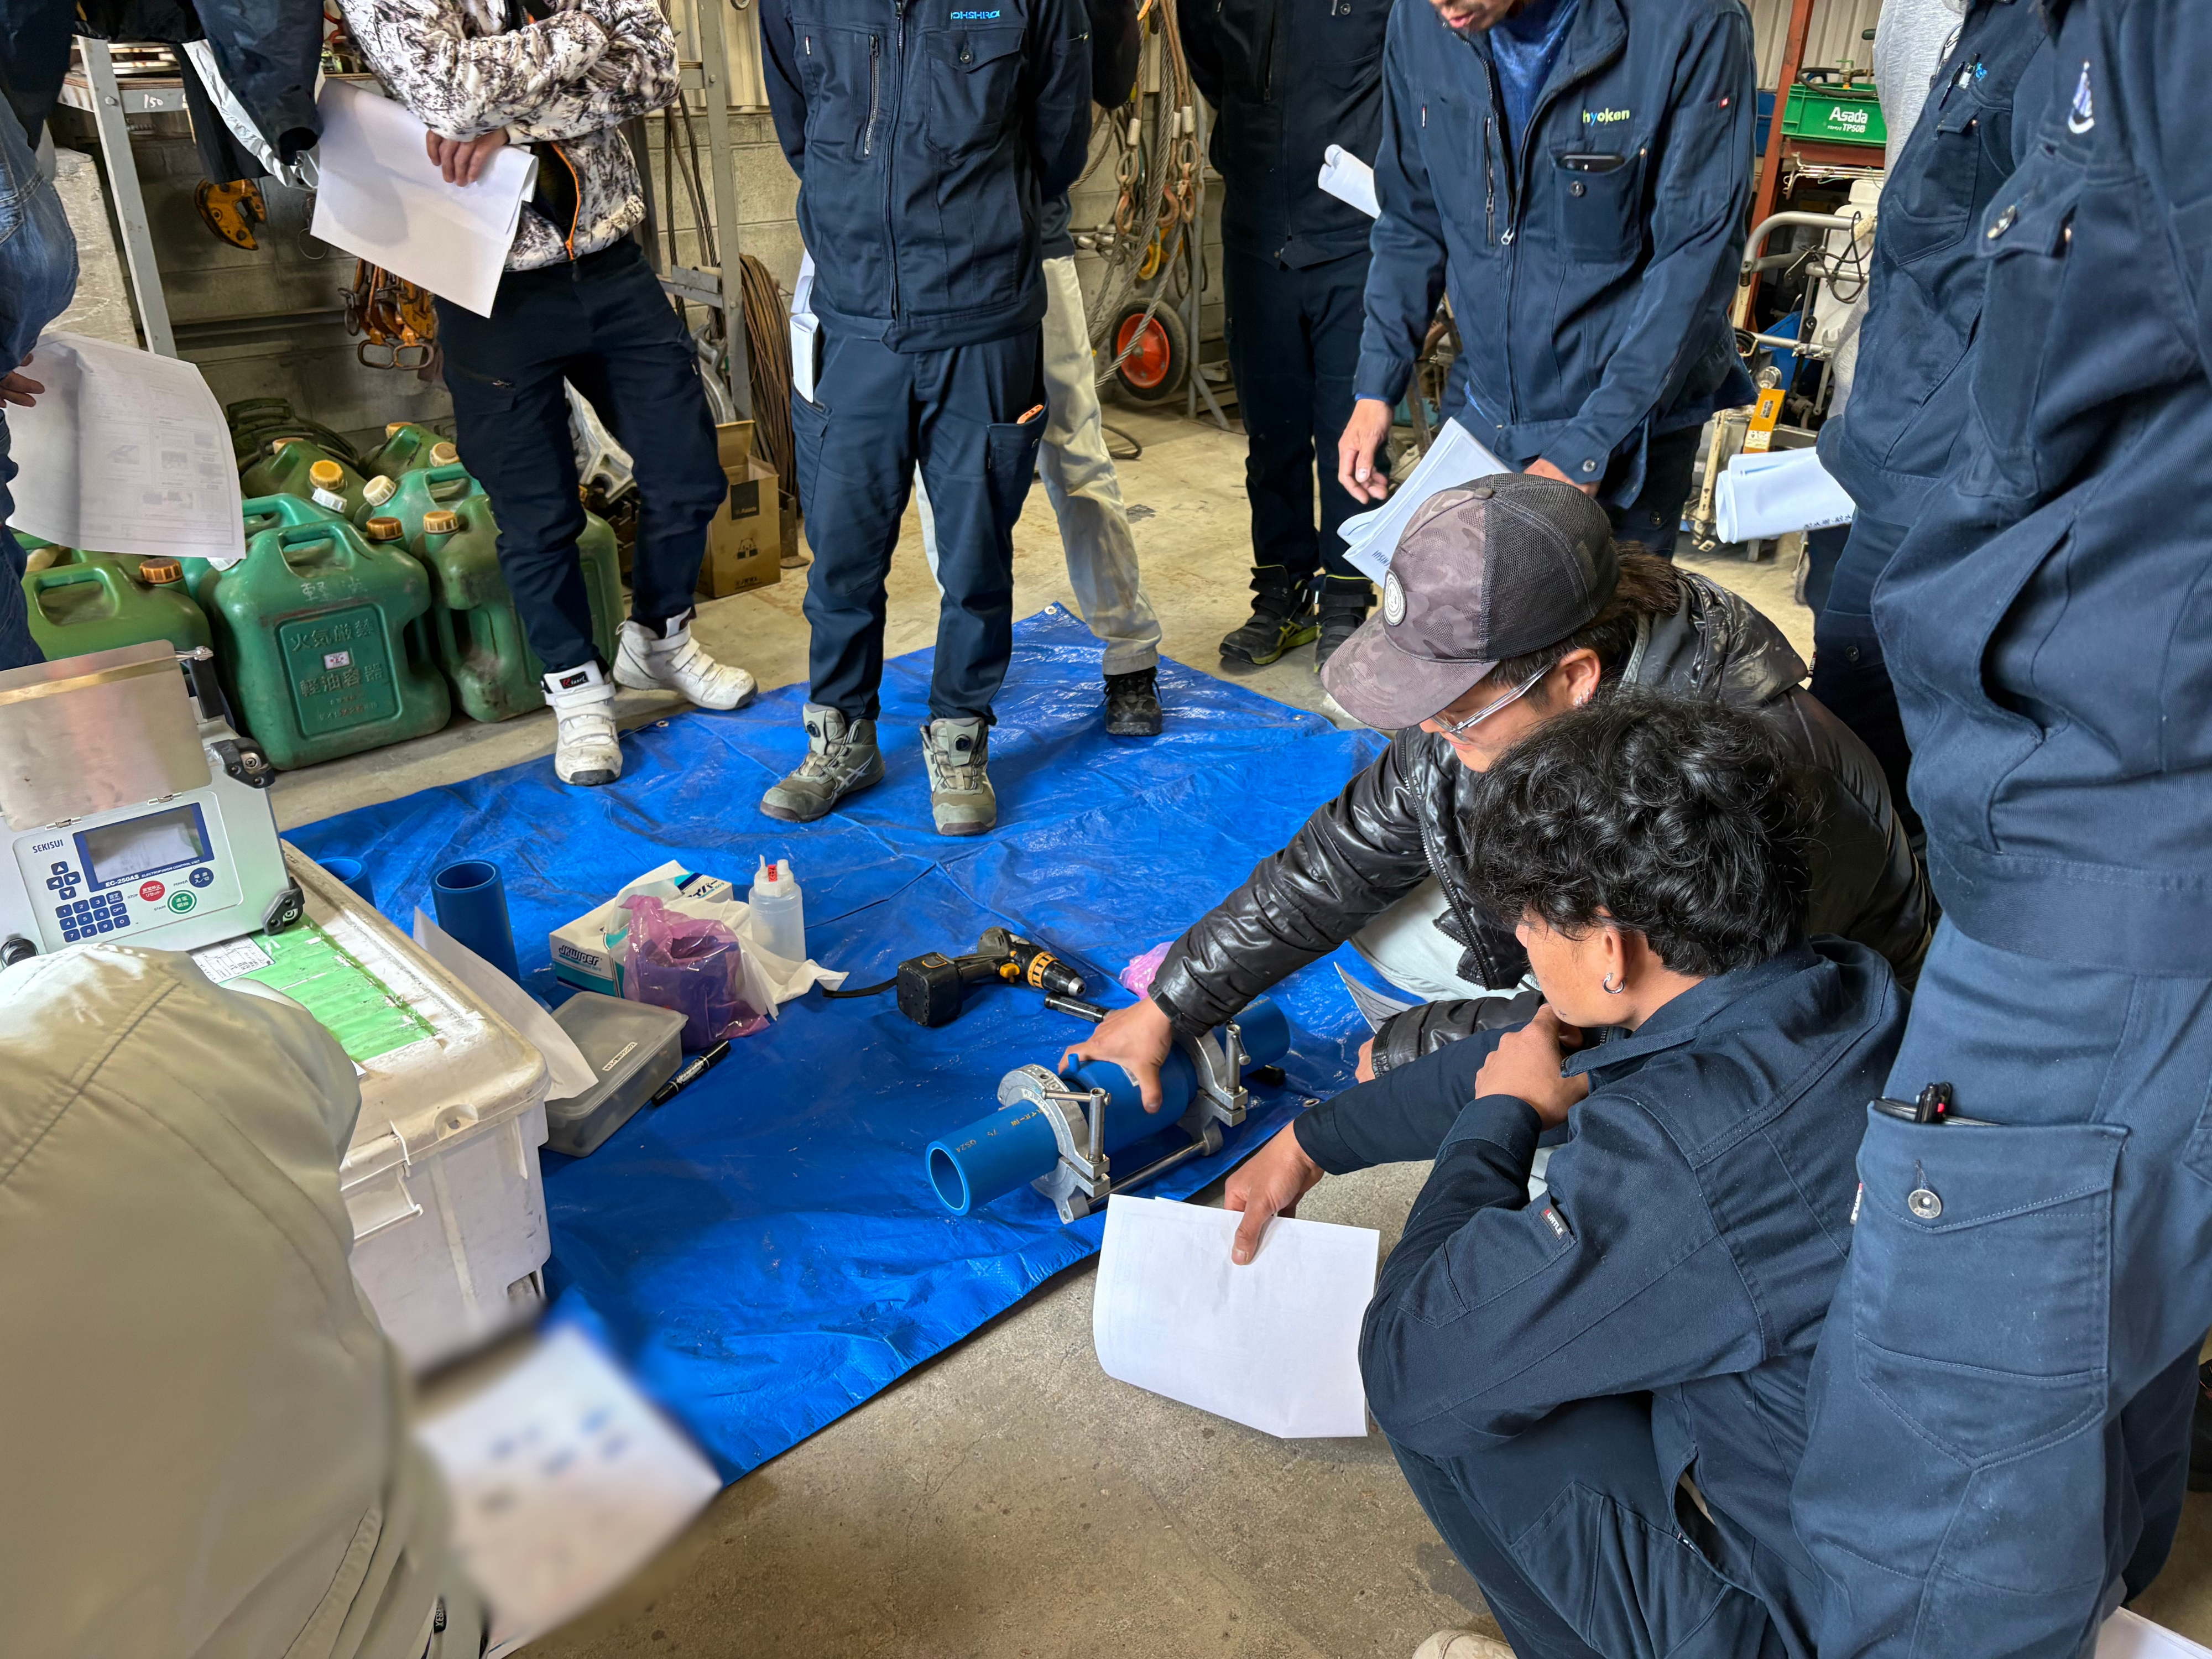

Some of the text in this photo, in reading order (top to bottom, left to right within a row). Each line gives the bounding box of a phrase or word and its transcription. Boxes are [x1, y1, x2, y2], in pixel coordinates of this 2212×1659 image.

[144, 94, 164, 108] 150
[1583, 108, 1630, 127] hyoken
[1829, 107, 1868, 124] Asada
[1843, 123, 1866, 133] TP50B
[1371, 550, 1391, 567] KISUI
[289, 618, 374, 652] 火気厳禁
[299, 663, 383, 697] 軽油容器
[32, 839, 64, 853] SEKISUI
[105, 874, 139, 888] EC-250AS
